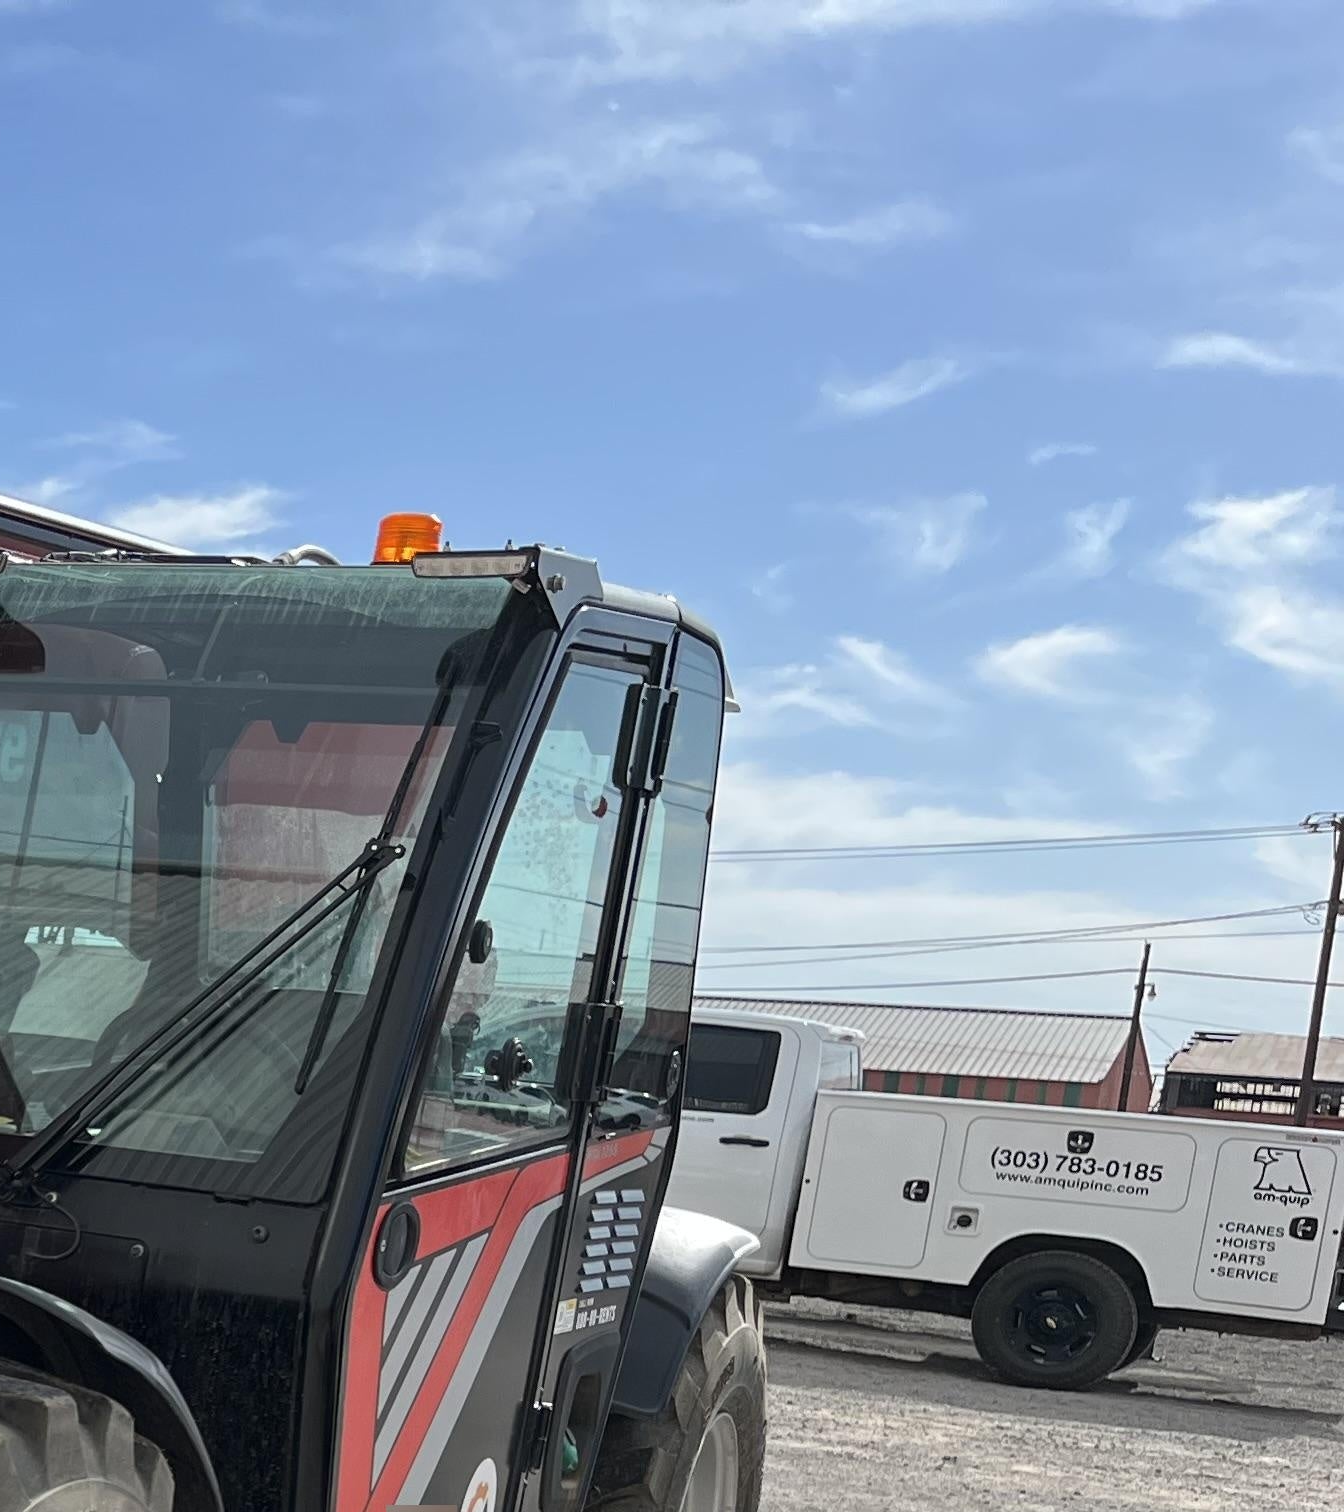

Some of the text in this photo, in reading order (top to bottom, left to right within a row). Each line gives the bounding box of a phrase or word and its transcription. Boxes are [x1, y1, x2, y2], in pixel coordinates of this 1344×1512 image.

[990, 1146, 1164, 1182] (303) 783-0185
[995, 1171, 1150, 1196] www.amquipinc.com
[1253, 1191, 1310, 1208] am-quip
[1225, 1221, 1285, 1238] CRANES
[1222, 1236, 1276, 1252] HOISTS
[1219, 1251, 1266, 1266] PARTS
[1217, 1266, 1279, 1283] SERVICE
